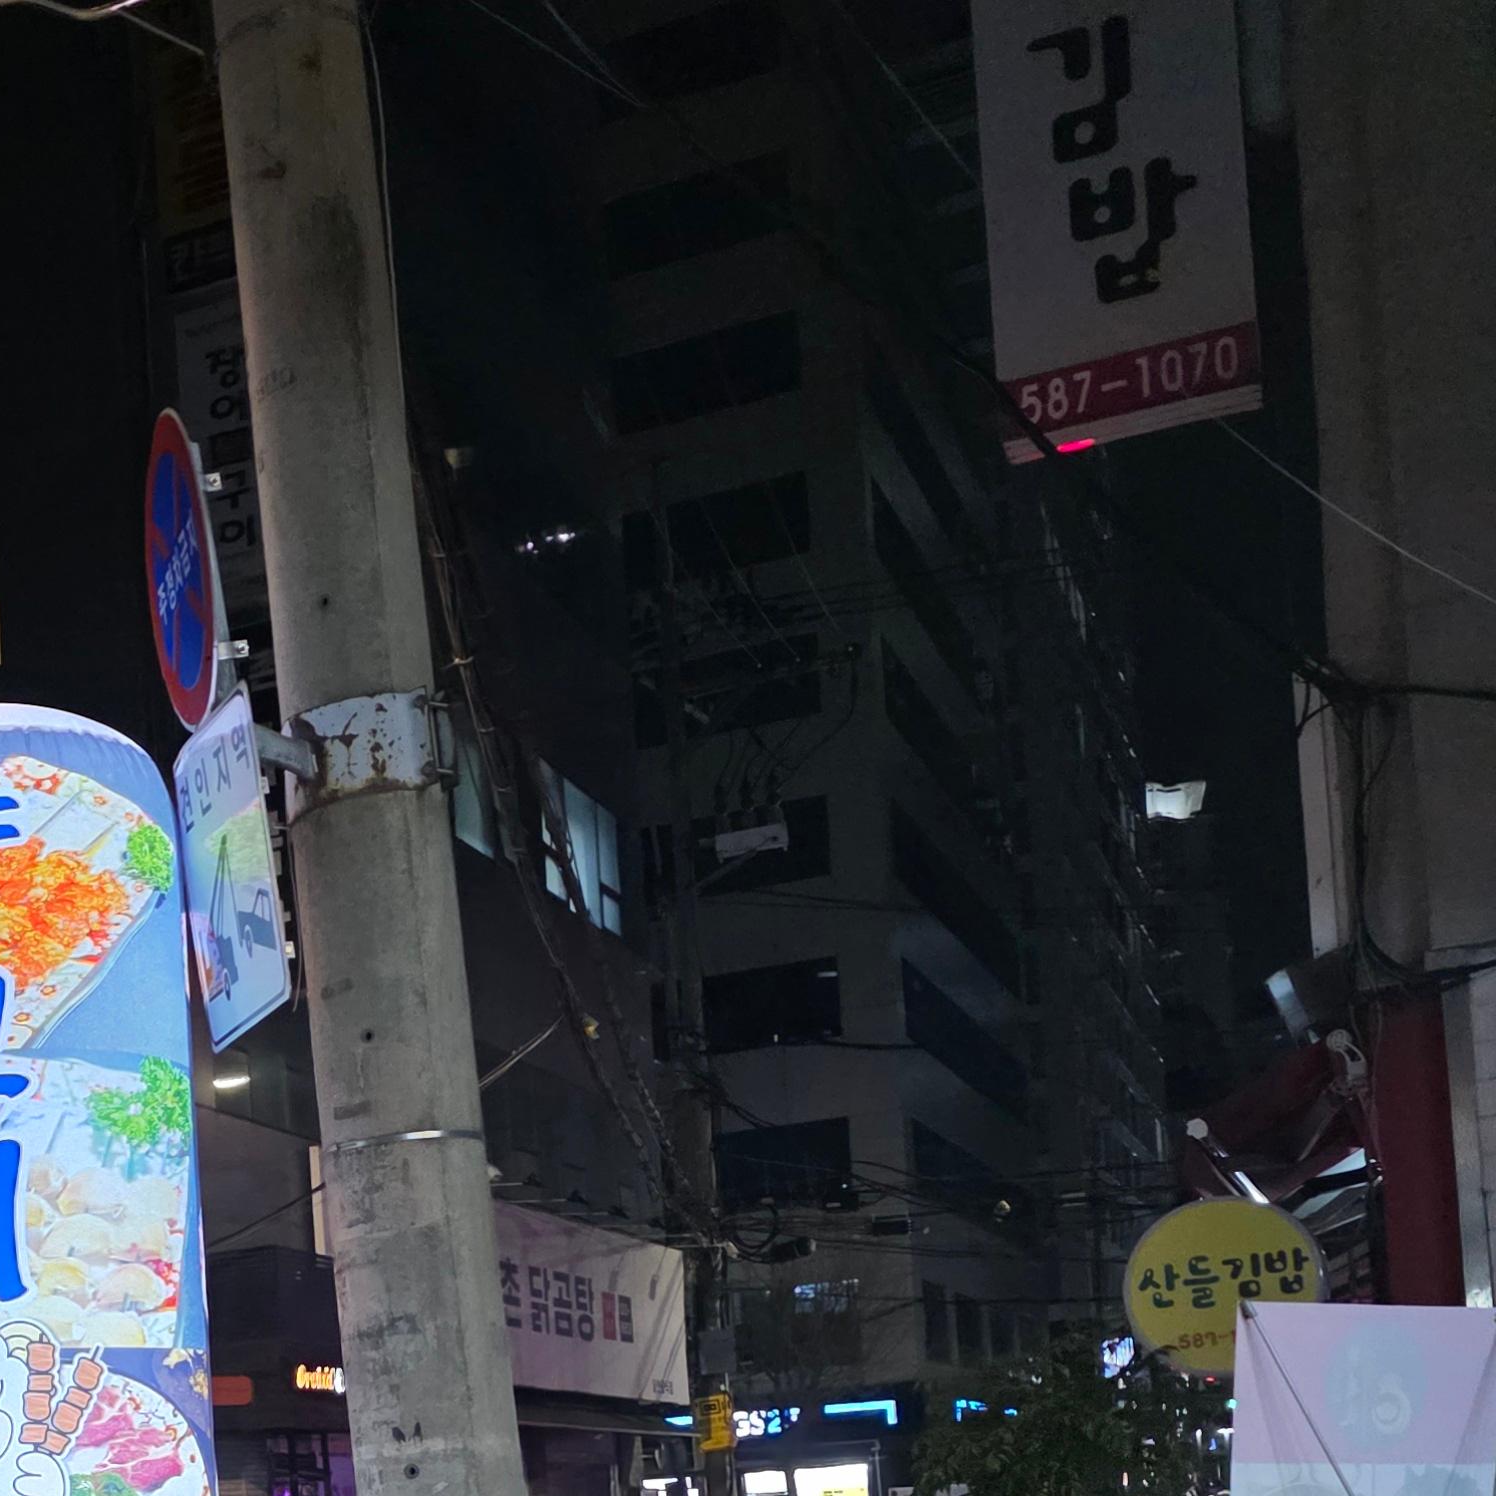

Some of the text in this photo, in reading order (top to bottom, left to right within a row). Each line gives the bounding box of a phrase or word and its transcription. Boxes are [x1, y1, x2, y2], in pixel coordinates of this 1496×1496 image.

[1026, 14, 1198, 303] 김밥
[1019, 336, 1238, 426] 587-1070
[1138, 1247, 1309, 1309] 산들김밥
